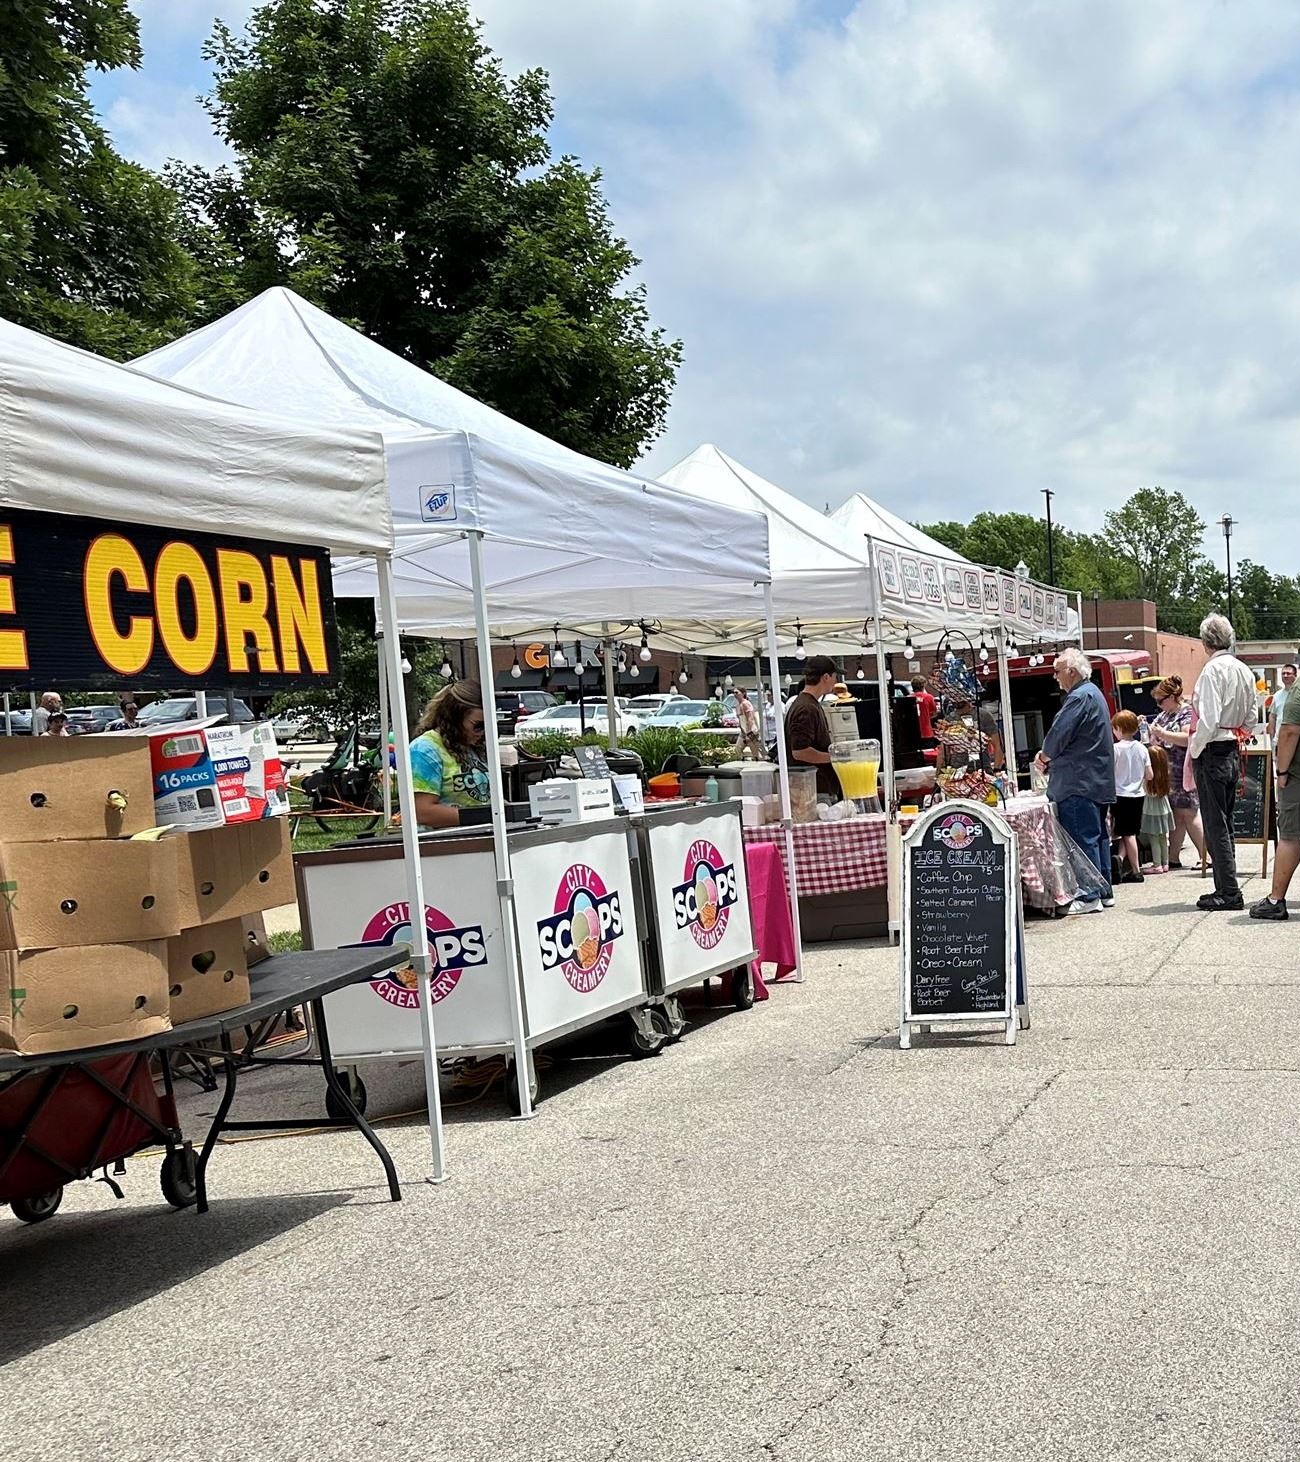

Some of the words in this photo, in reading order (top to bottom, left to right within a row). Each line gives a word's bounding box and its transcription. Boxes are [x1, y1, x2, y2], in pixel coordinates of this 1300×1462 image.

[923, 567, 934, 581] HOT
[924, 583, 940, 599] DOGS
[984, 583, 998, 602] BRATS
[83, 532, 329, 675] CORN
[228, 759, 248, 770] TOWELS
[160, 772, 181, 788] 16
[181, 771, 210, 783] PACKS
[691, 841, 712, 863] CITY
[914, 850, 943, 865] ICE
[947, 850, 996, 865] CREAM
[566, 865, 592, 891] CITY
[920, 871, 950, 883] Coffee
[952, 870, 973, 884] Chip
[920, 886, 949, 894] Southern
[953, 886, 979, 894] Bourbon
[920, 899, 945, 907] Salted
[947, 897, 977, 907] Caramel
[921, 910, 970, 922] Strawberry
[692, 910, 728, 948] CREAMERY
[922, 923, 947, 932] Vanilla
[921, 934, 963, 942] Chocolate
[965, 932, 989, 942] Velvet
[921, 946, 941, 955] Root
[945, 945, 963, 954] Beer
[964, 944, 989, 954] Float
[565, 947, 611, 991] CREAMERY
[921, 958, 945, 968] Oreo
[952, 956, 982, 968] Cream
[935, 975, 950, 983] Free
[376, 972, 456, 1007] CREAERY
[917, 989, 931, 997] Root
[934, 988, 951, 996] Beer
[917, 998, 945, 1006] Sorbet
